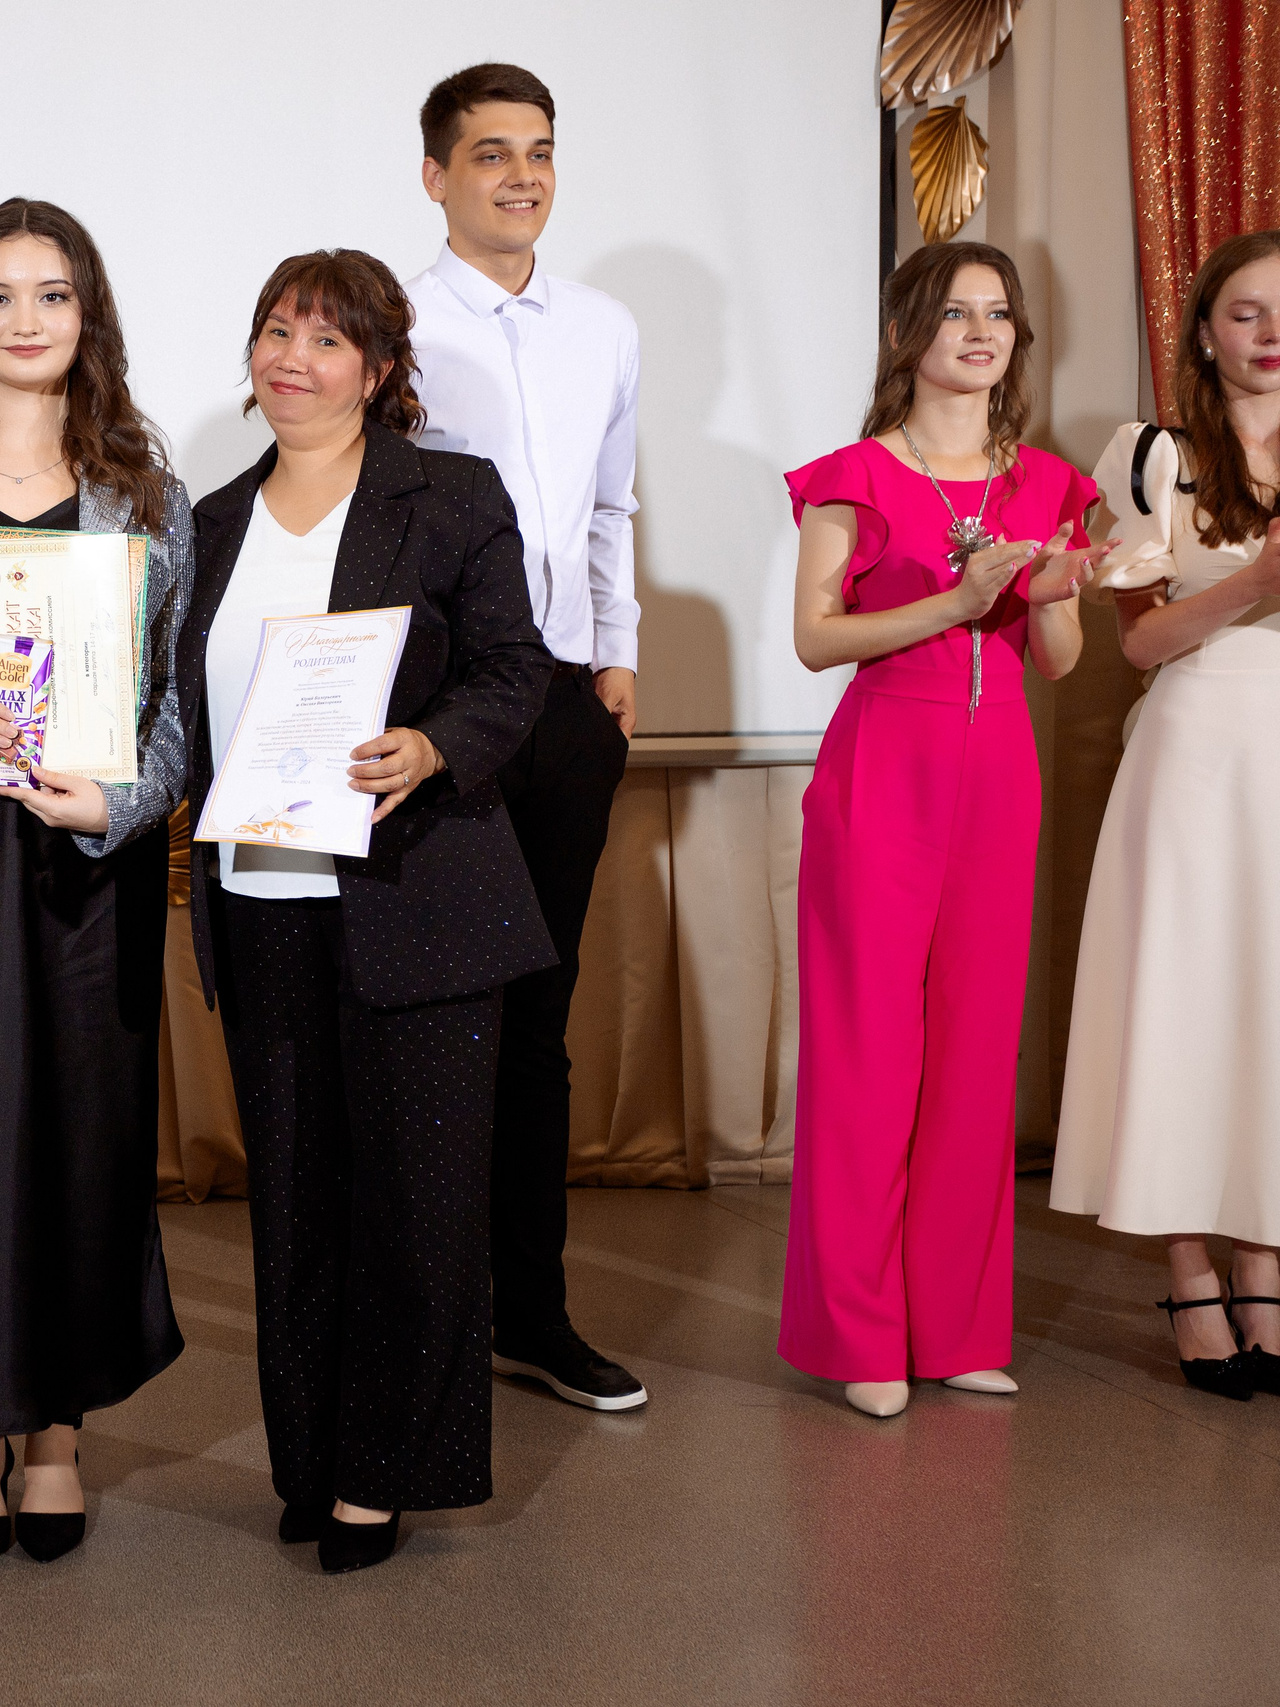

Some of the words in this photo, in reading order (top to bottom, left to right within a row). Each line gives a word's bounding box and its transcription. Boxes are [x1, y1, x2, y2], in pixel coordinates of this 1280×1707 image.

[285, 625, 379, 658] Благодарность
[293, 655, 356, 668] РОДИТЕЛЯМ
[0, 671, 25, 683] Gold
